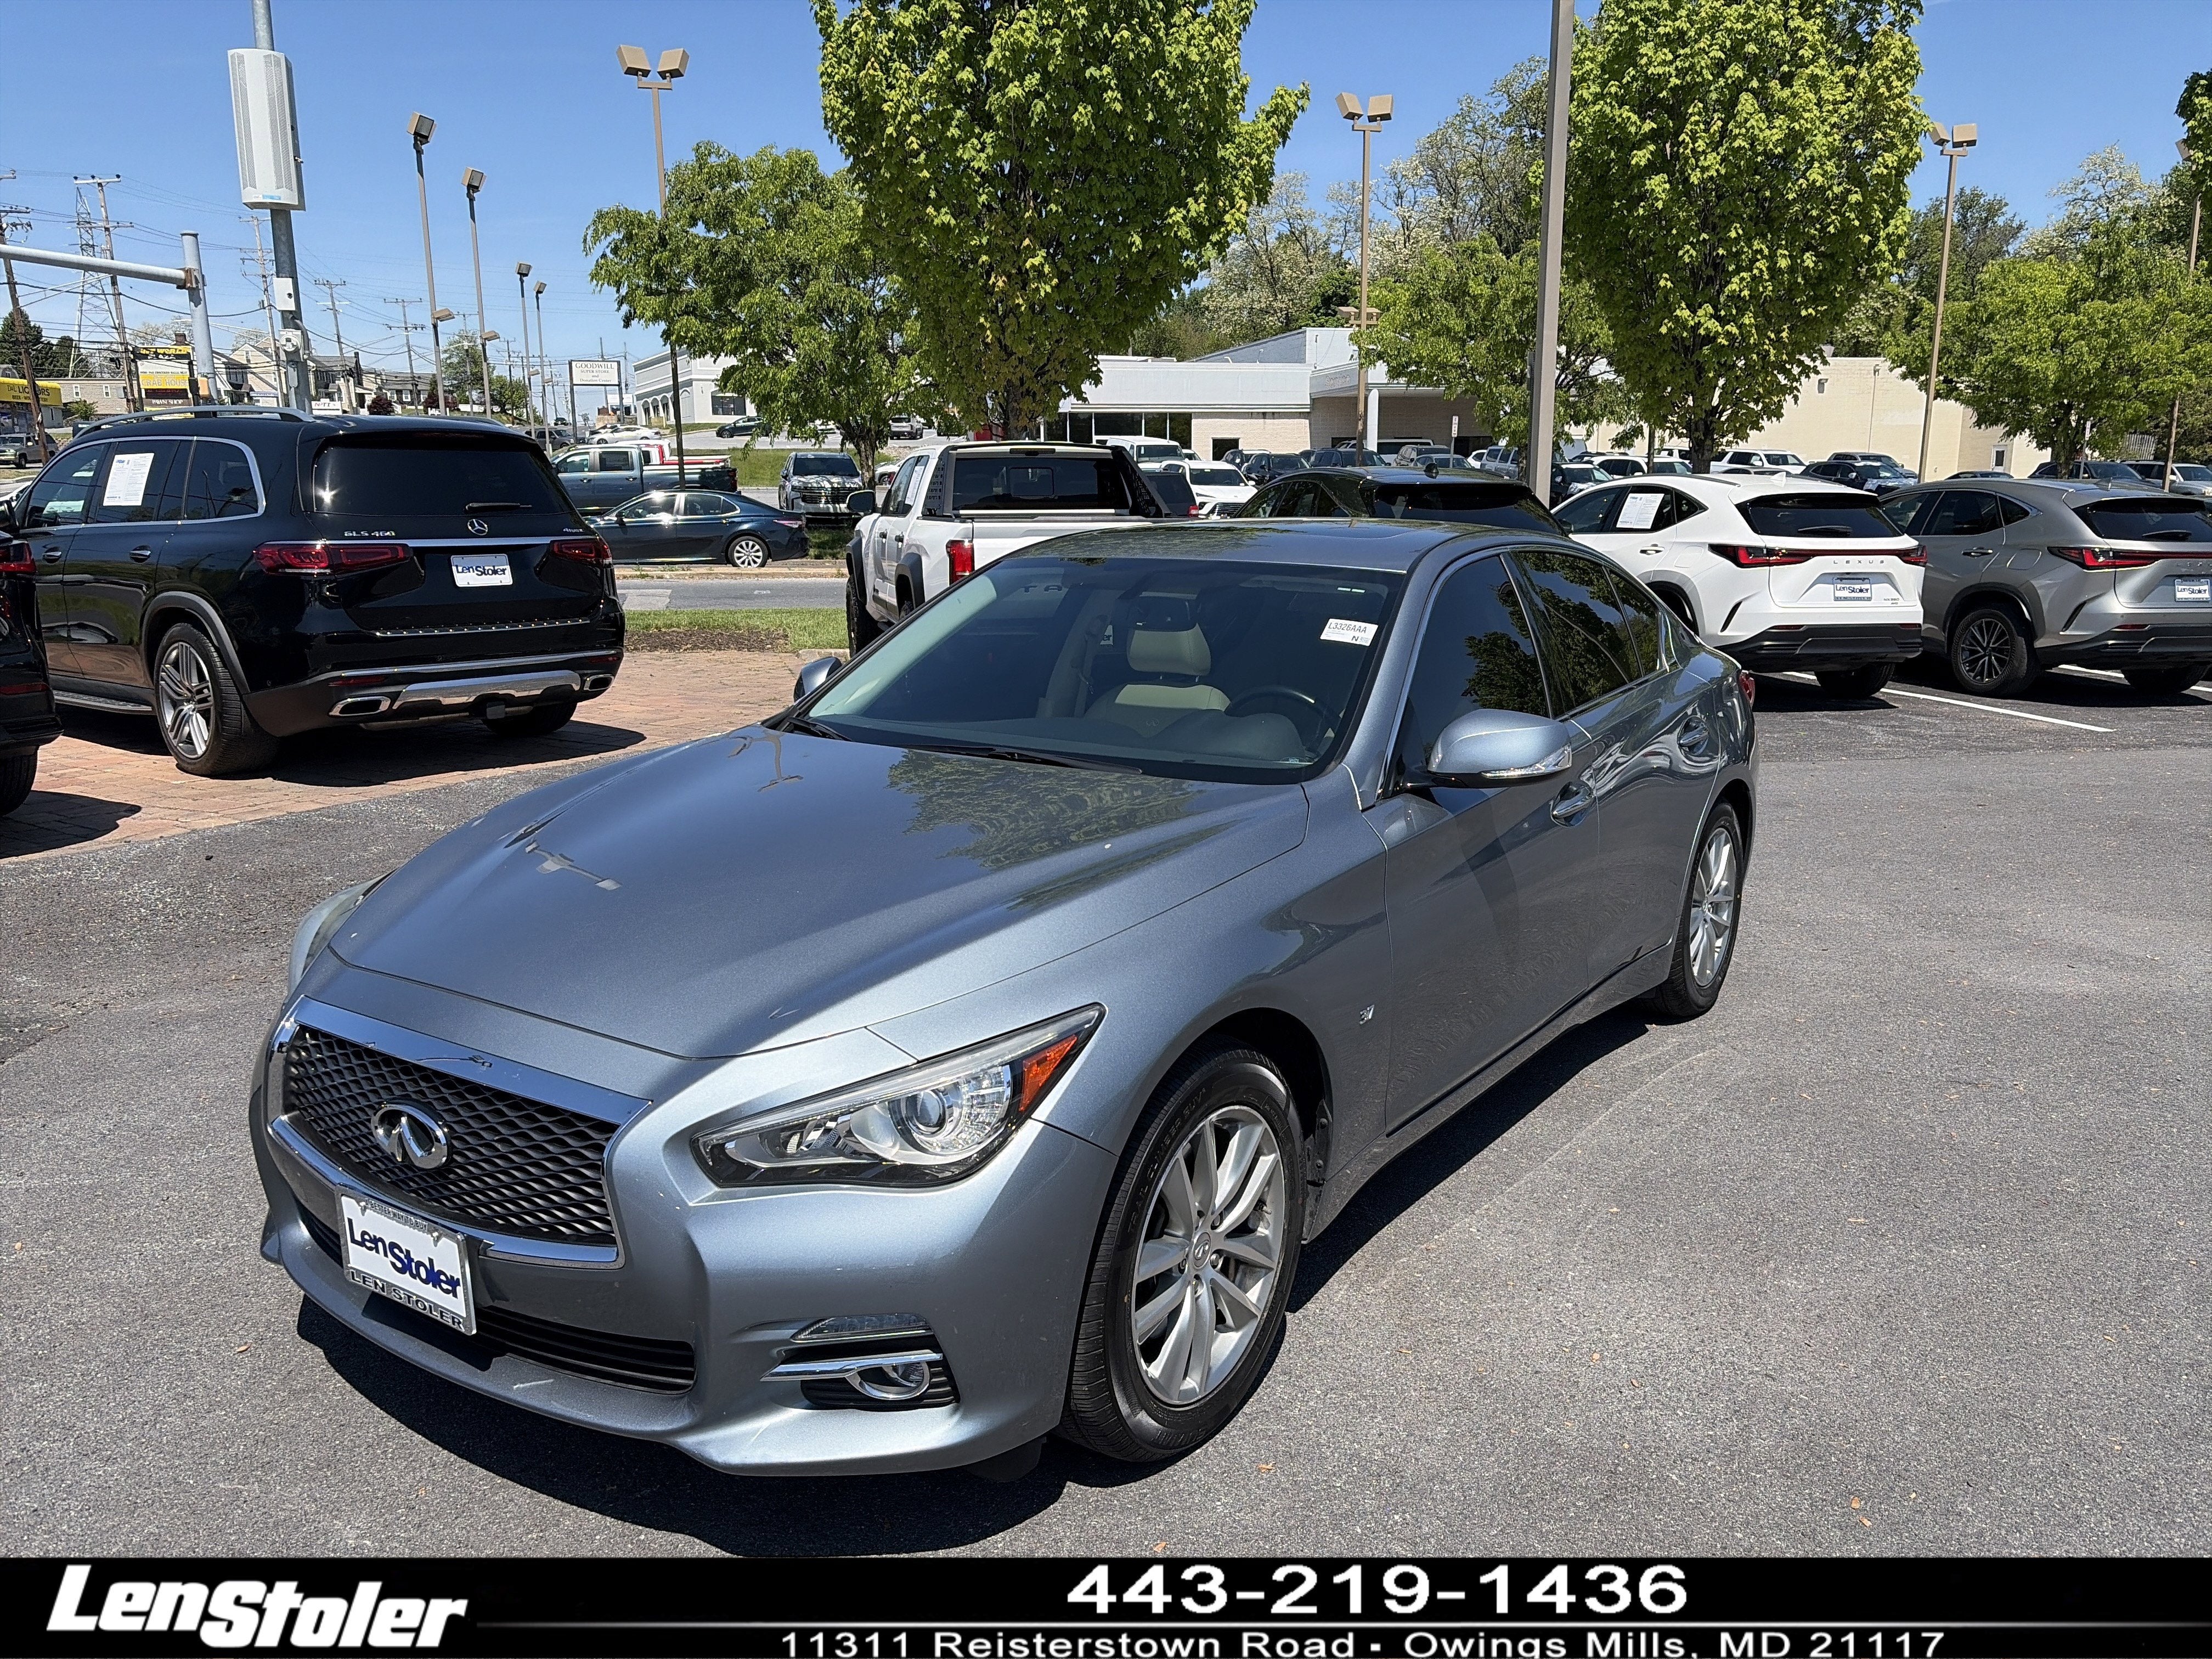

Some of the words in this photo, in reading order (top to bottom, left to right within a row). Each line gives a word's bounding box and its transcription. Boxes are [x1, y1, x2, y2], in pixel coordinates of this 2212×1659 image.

[1328, 622, 1367, 634] L3326AAA
[350, 1269, 387, 1295] LEN
[391, 1287, 465, 1332] STOLER
